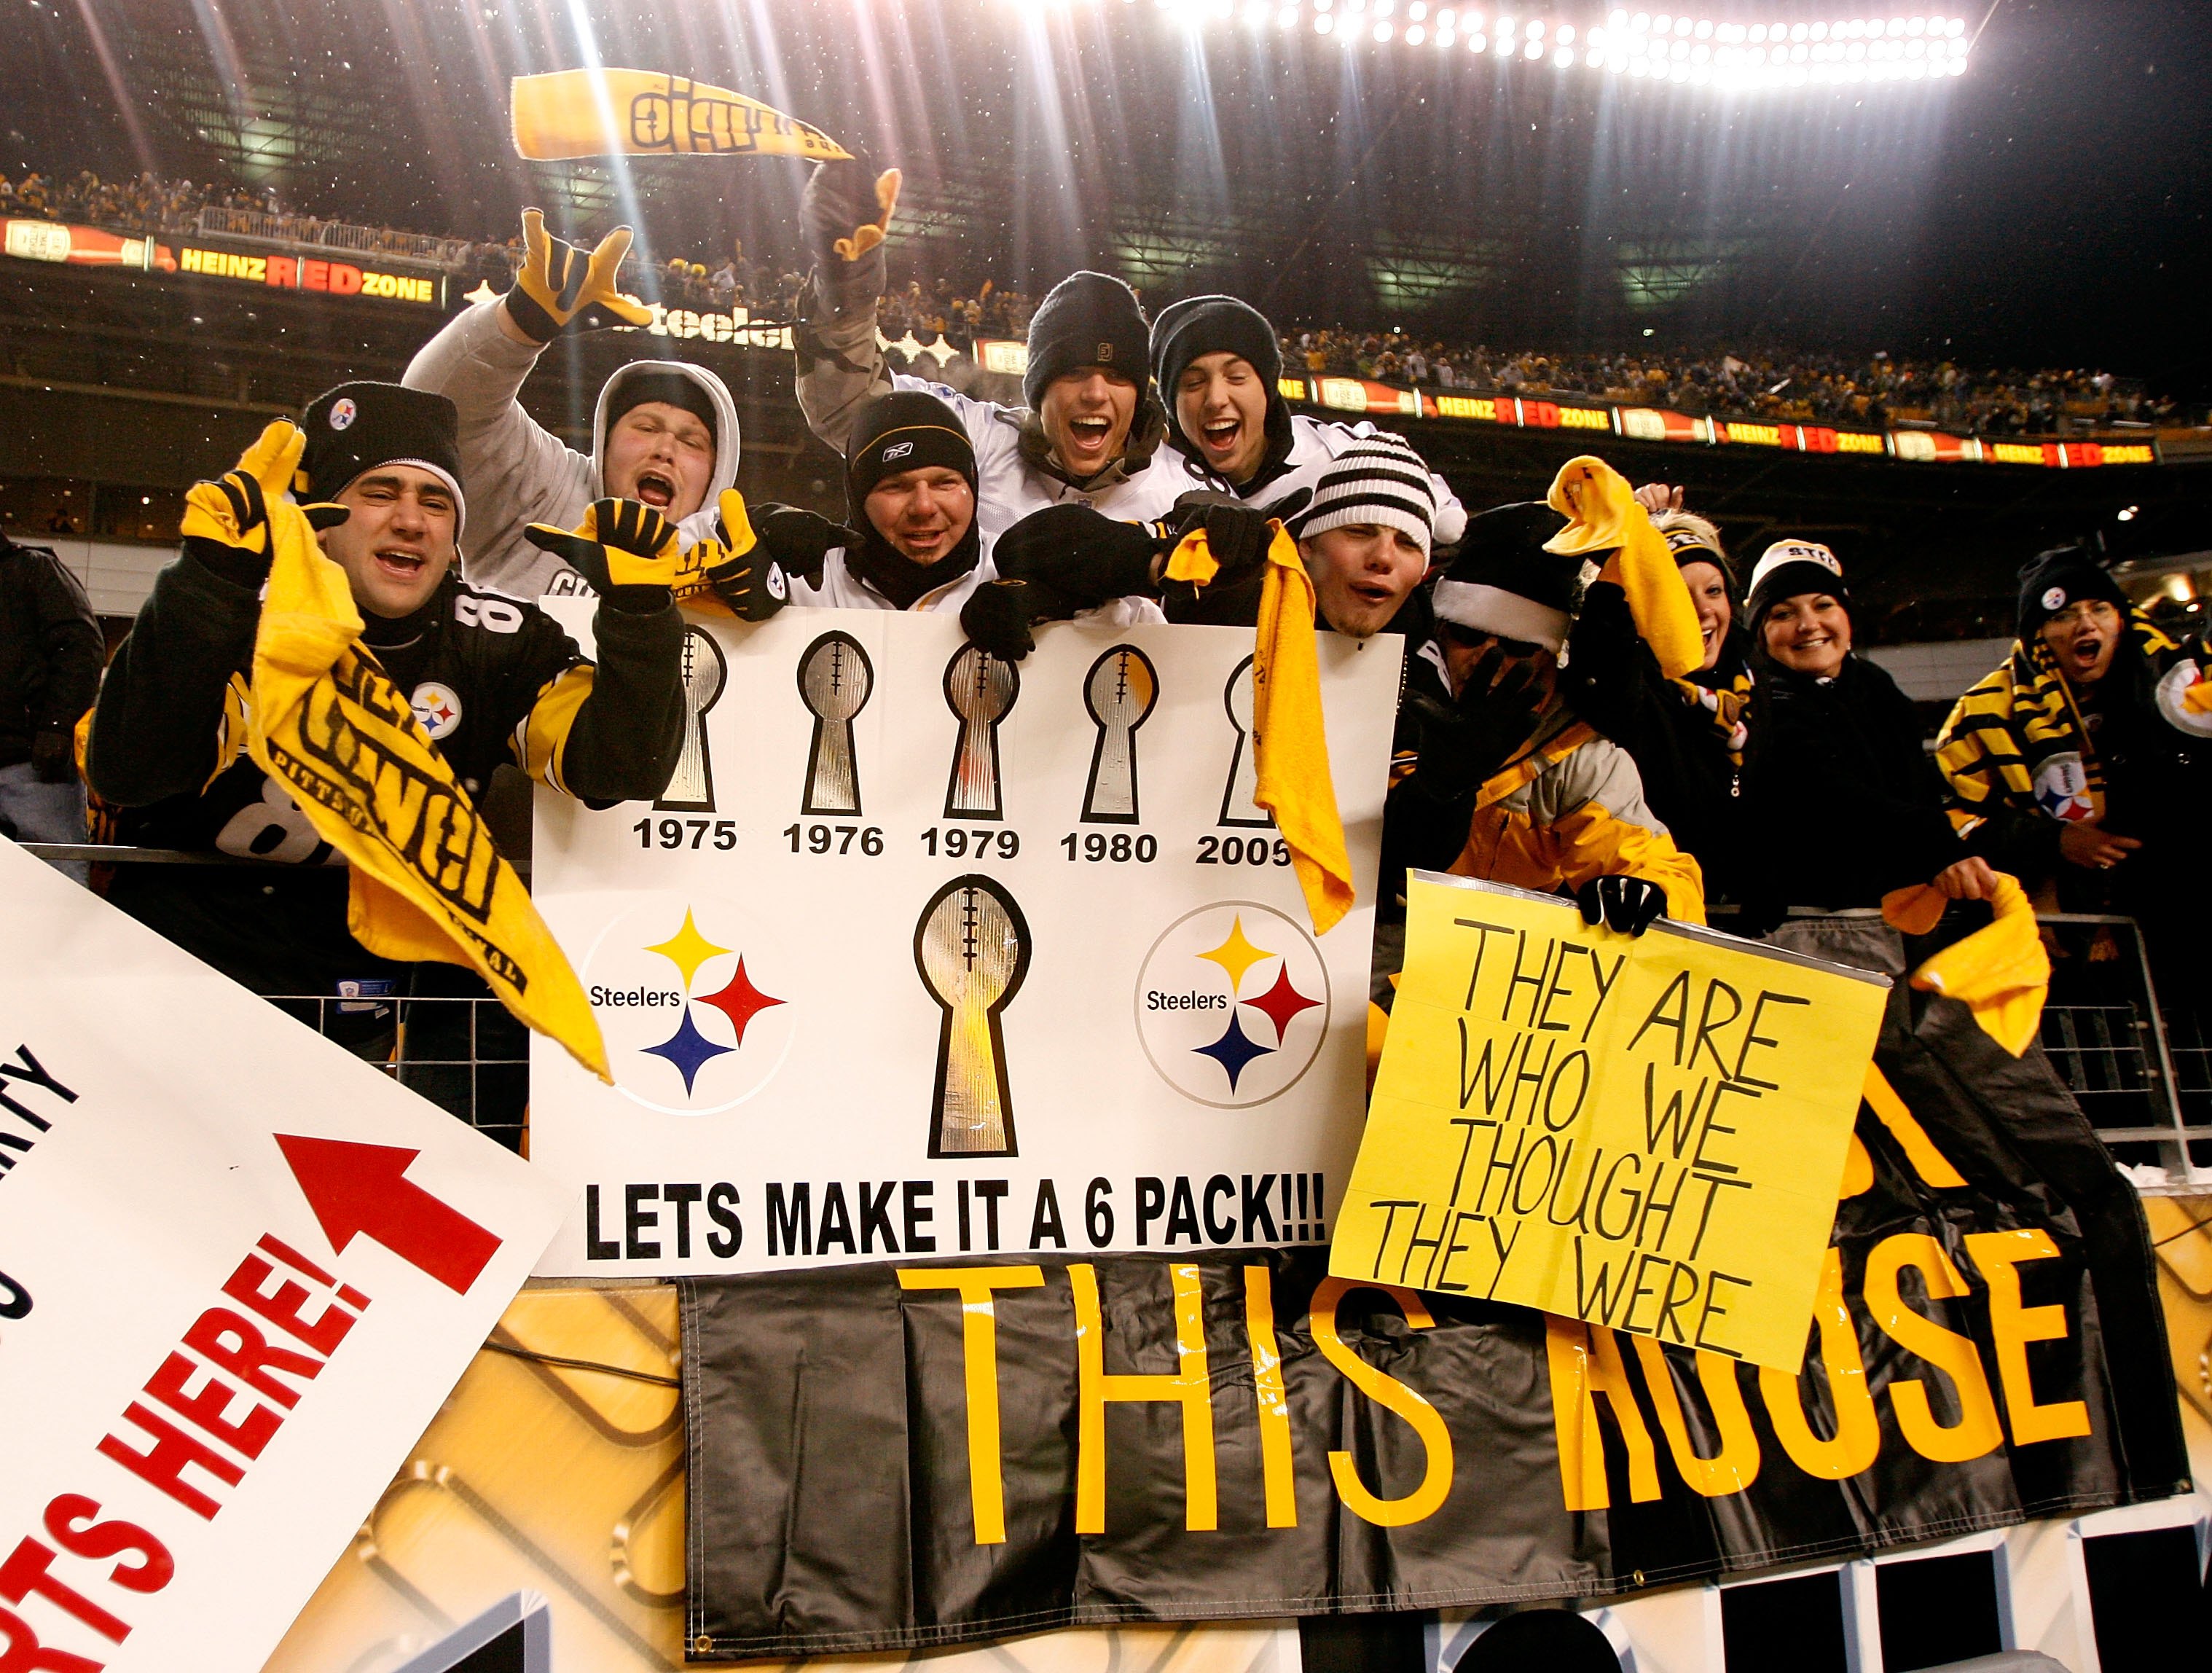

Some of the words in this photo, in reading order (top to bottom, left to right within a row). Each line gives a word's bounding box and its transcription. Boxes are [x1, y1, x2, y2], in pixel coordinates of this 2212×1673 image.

[181, 248, 267, 282] HEINZ
[266, 255, 363, 295] RED
[361, 272, 433, 302] ZONE
[1436, 396, 1497, 420] HEINZ
[1494, 397, 1561, 428] RED
[1558, 407, 1610, 430] ZONE
[1726, 423, 1781, 446] HEINZ
[1836, 432, 1885, 453] ZONE
[1993, 443, 2044, 465] HEINZ
[2101, 446, 2154, 465] ZONE
[633, 818, 737, 850] 1975
[783, 823, 884, 856] 1976
[920, 827, 1020, 860] 1979
[1060, 833, 1157, 863] 1980
[1196, 836, 1291, 866] 2005
[590, 986, 680, 1006] Steelers
[1148, 990, 1227, 1010] Steelers
[1454, 917, 1625, 1042] THEY
[1628, 970, 1810, 1091] ARE
[1458, 1017, 1591, 1132] WHO
[1644, 1062, 1762, 1174] WE
[587, 1182, 742, 1259] LETS
[766, 1180, 936, 1256] MAKE
[957, 1179, 1008, 1251] IT
[1029, 1178, 1067, 1249] A
[1085, 1177, 1115, 1248] 6
[1135, 1172, 1325, 1246] PACK!!!
[1449, 1118, 1752, 1261] THOUGHT
[1370, 1200, 1521, 1299] THEY
[1574, 1236, 1752, 1358] WERE
[95, 1231, 372, 1522] HERE!
[896, 1263, 1454, 1545] THIS
